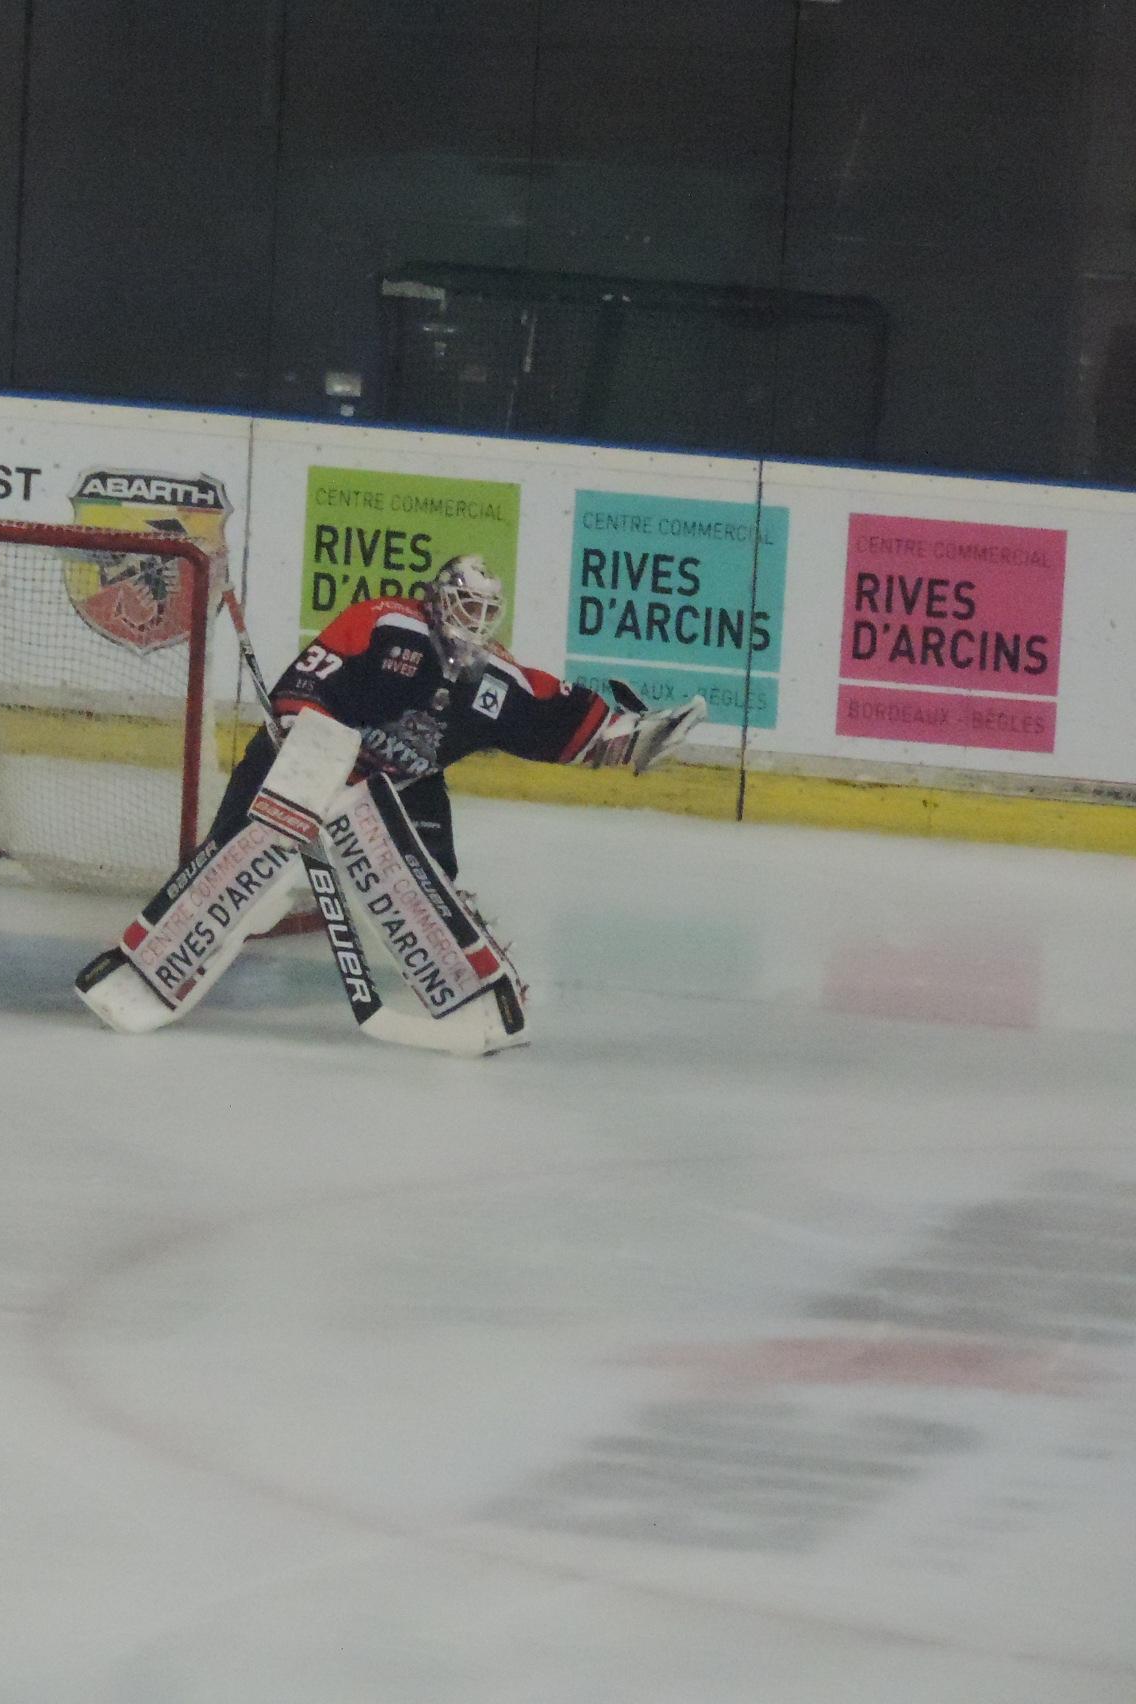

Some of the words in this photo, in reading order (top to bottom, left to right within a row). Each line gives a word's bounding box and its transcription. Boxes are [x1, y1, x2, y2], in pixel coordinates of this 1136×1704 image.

[72, 477, 215, 506] ABARTH
[315, 487, 384, 512] CENTRE
[390, 493, 505, 522] COMMERCIAL
[315, 524, 433, 573] RIVES
[582, 511, 653, 535] CENTRE
[658, 518, 775, 546] COMMERCIAL
[855, 535, 929, 559] CENTRE
[933, 540, 1052, 569] COMMERCIAL
[312, 572, 431, 612] D'AR
[582, 547, 701, 597] RIVES
[855, 572, 977, 621] RIVES
[578, 595, 771, 651] D'ARCINS
[295, 645, 344, 681] 37
[851, 620, 1049, 676] D'ARCINS
[576, 676, 675, 701] ORAUX
[847, 701, 949, 726] BORDEAUX
[190, 825, 269, 908] COMMERC
[405, 854, 452, 918] BAUER
[155, 922, 215, 989] RIVES
[208, 844, 298, 928] D'ARCIN
[326, 814, 379, 894] RIVES
[368, 894, 455, 1007] D'ARCINS
